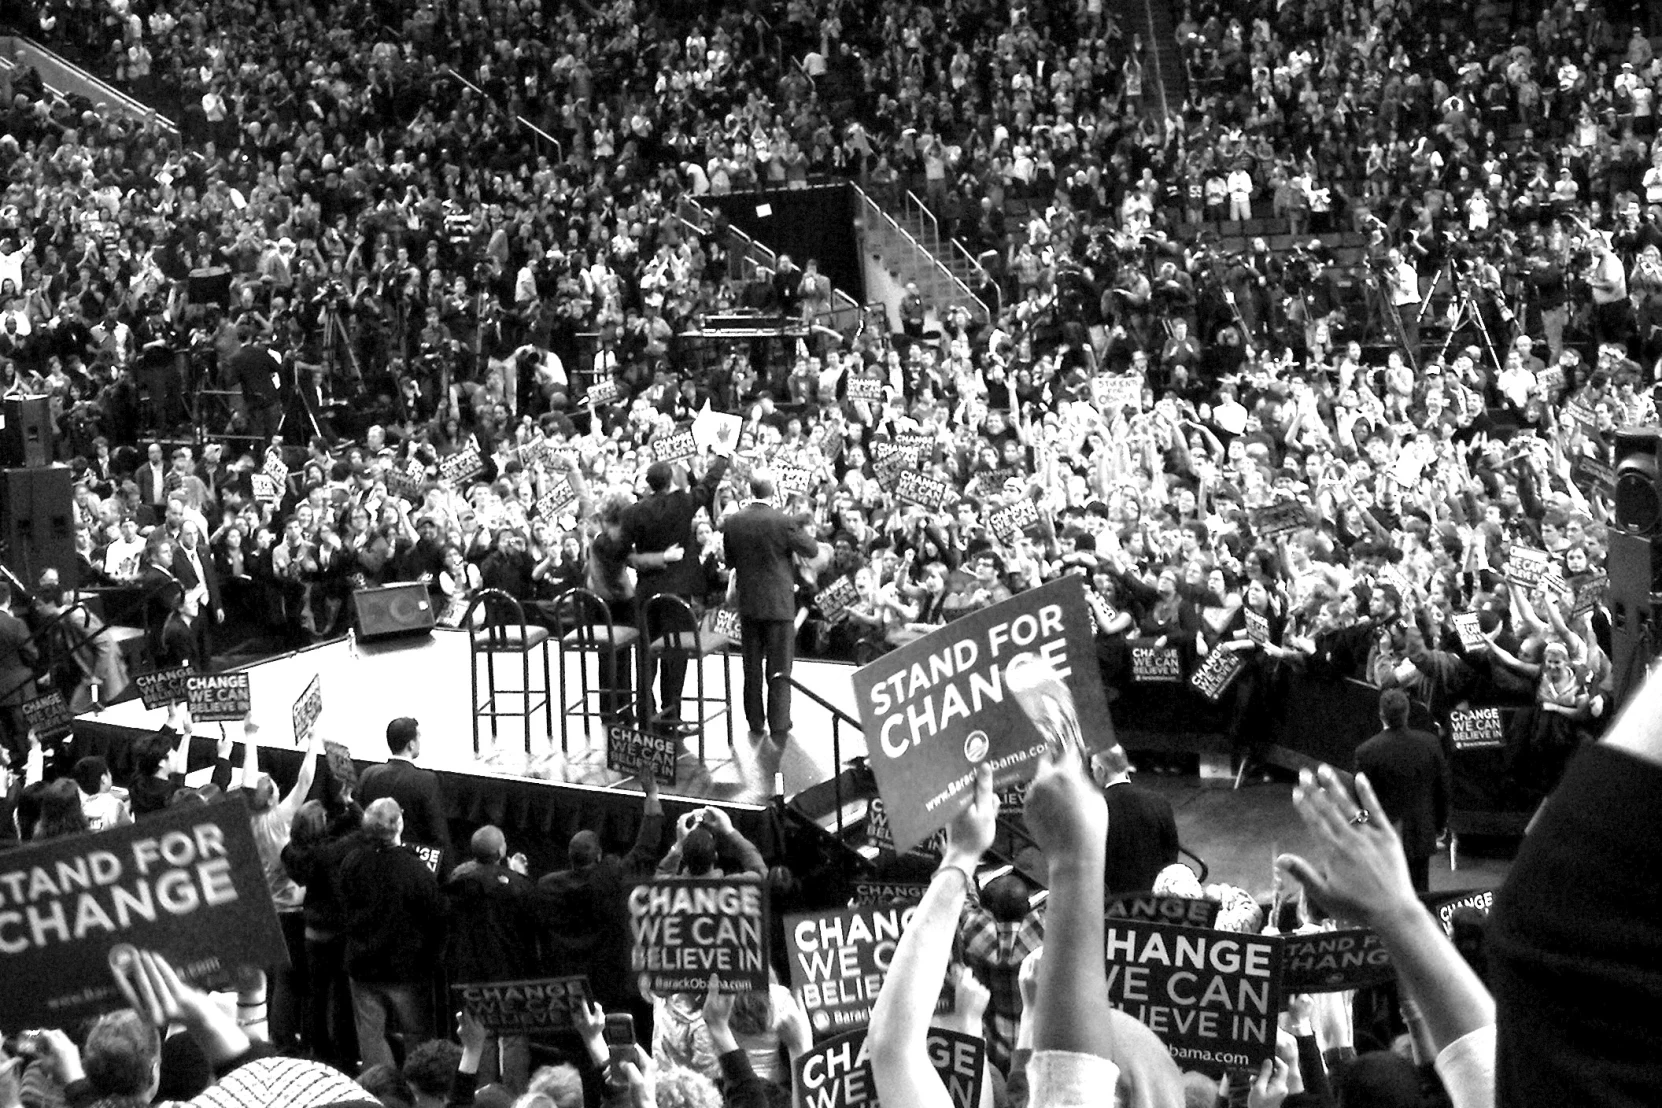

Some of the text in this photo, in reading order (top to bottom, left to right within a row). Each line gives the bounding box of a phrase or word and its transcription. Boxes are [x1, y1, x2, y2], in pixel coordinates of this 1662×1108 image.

[870, 638, 979, 716] STAND
[988, 604, 1066, 658] FOR
[186, 675, 248, 691] CHANGE
[188, 691, 212, 704] WE
[216, 689, 249, 702] CAN
[189, 701, 236, 714] BELIEVE
[610, 726, 676, 755] CHANGE
[1451, 719, 1501, 732] WE CAN
[1452, 730, 1492, 741] BELIEVE
[611, 738, 676, 767] WE CAN
[0, 822, 227, 907] TAND FOR
[628, 885, 763, 917] CHANGE
[629, 915, 762, 947] WE CAN
[630, 947, 763, 972] BELIEVE IN
[797, 945, 862, 983] WE
[1106, 927, 1273, 978] HANGE
[1166, 970, 1270, 1016] CAN
[1232, 1014, 1268, 1045] IN
